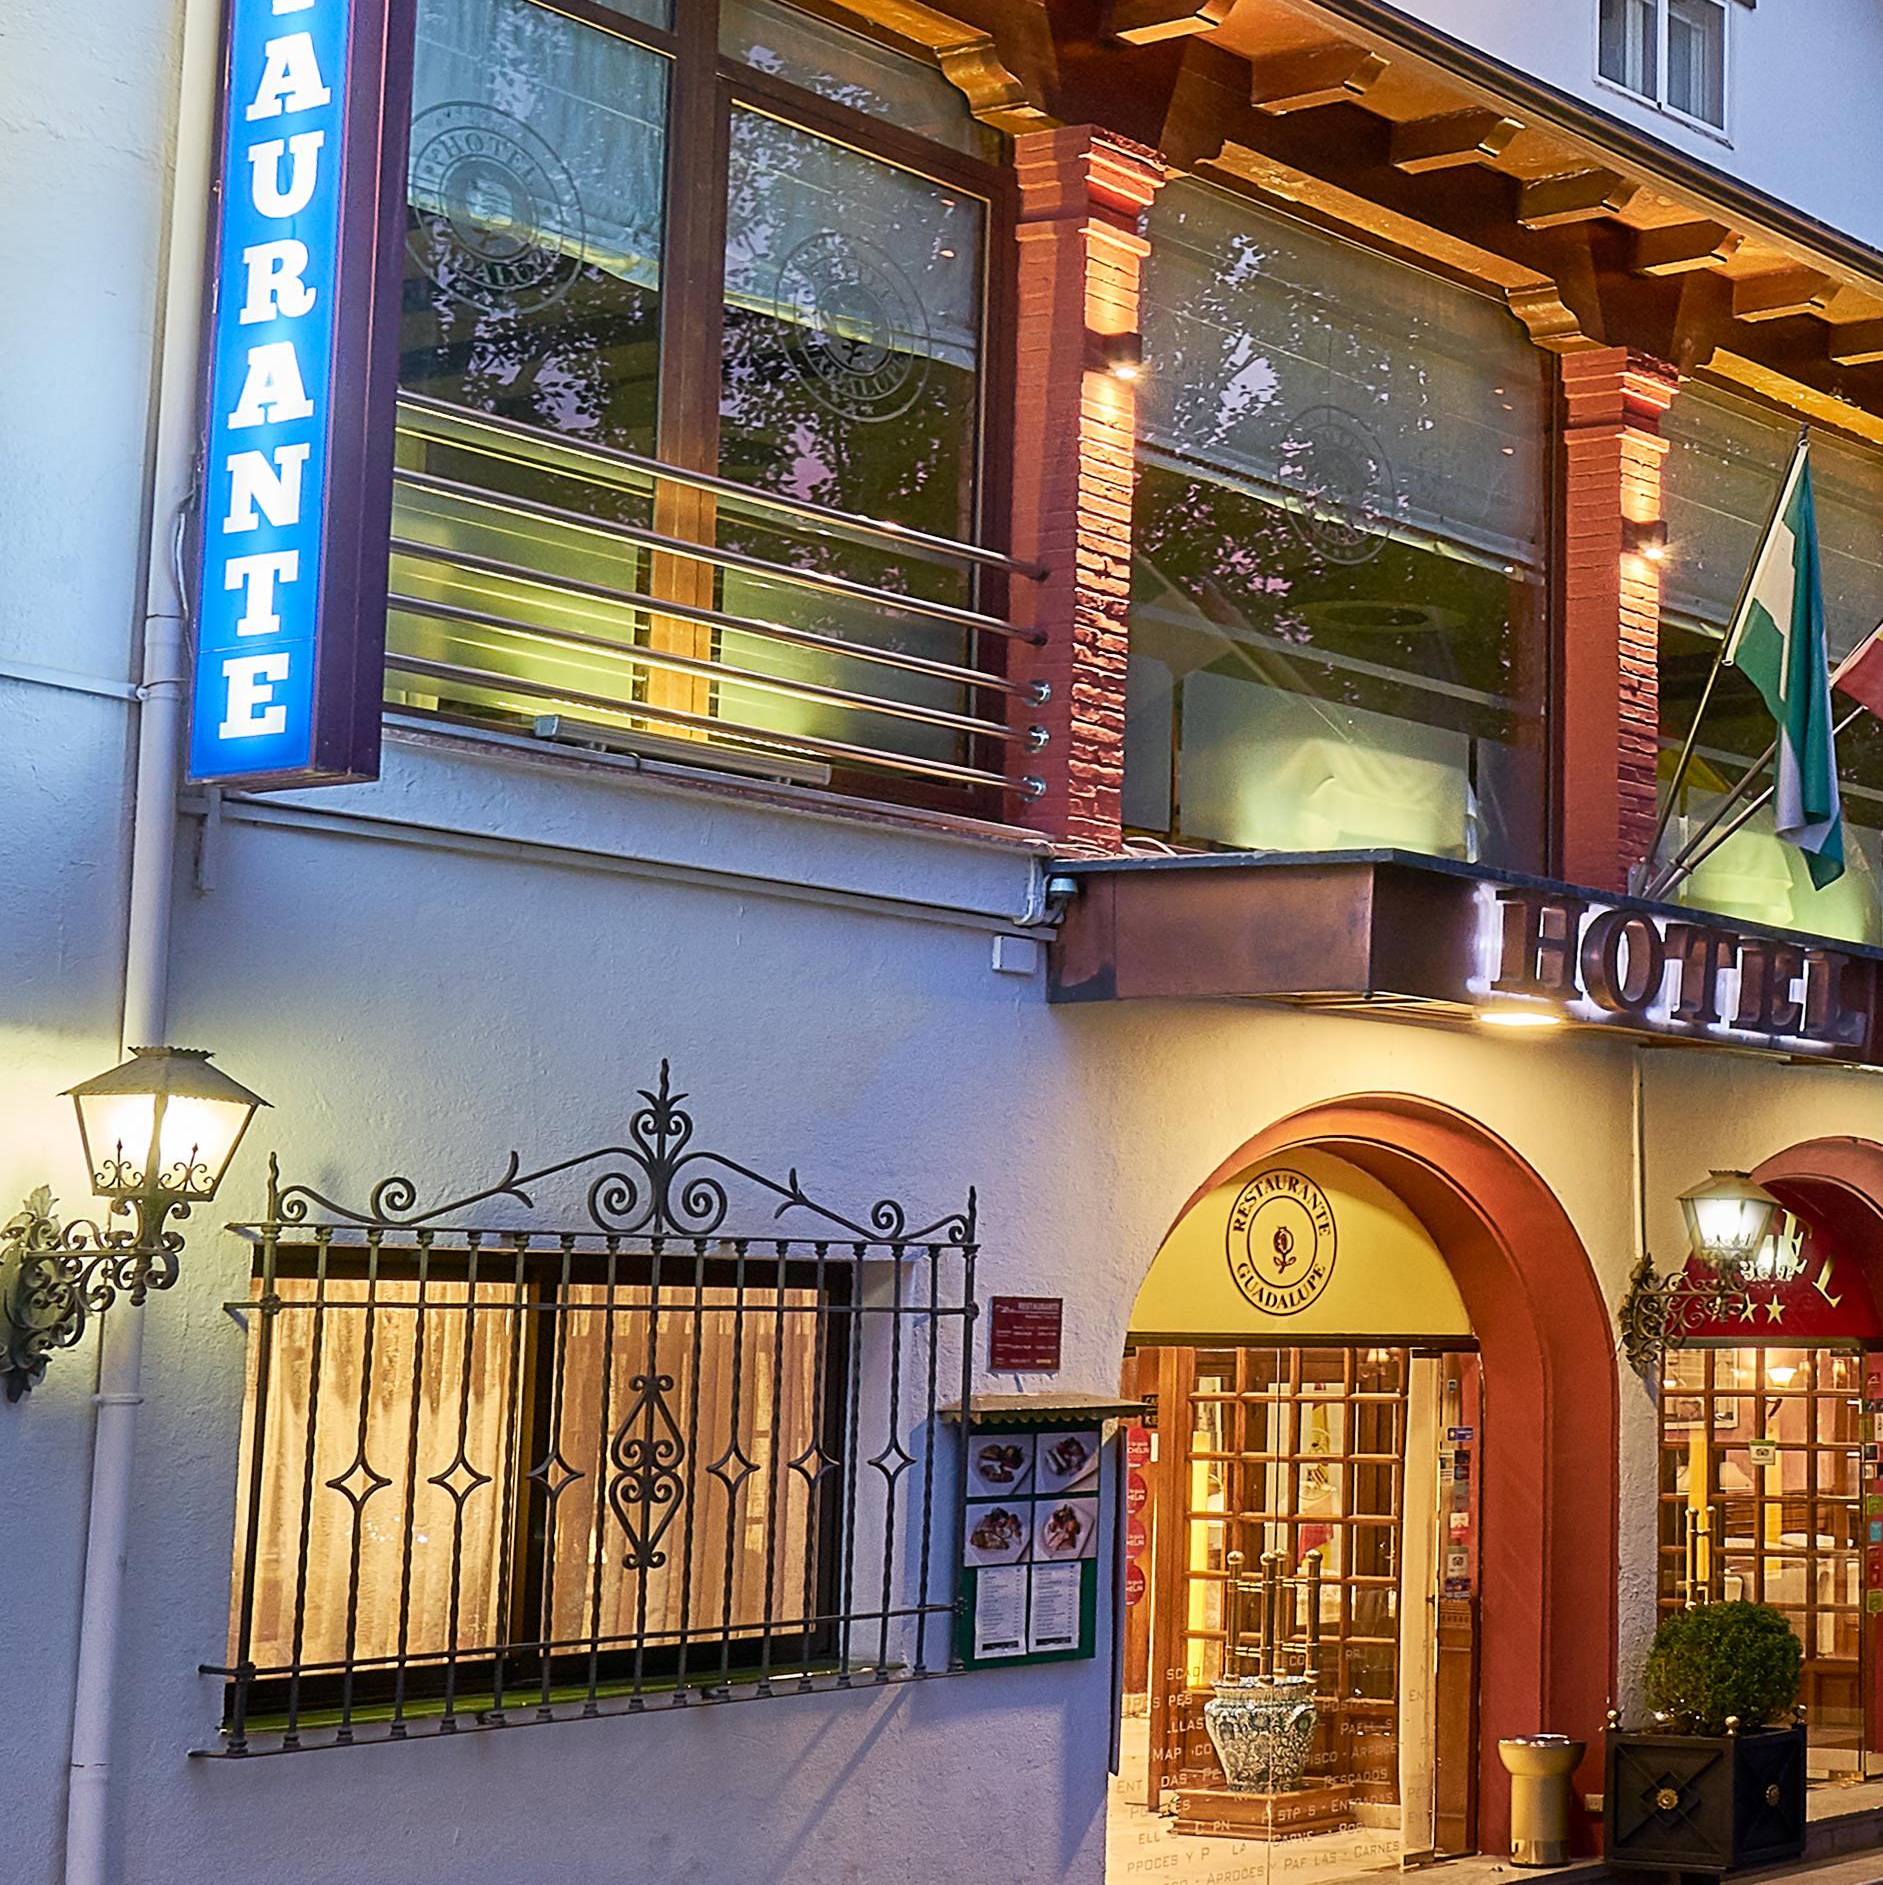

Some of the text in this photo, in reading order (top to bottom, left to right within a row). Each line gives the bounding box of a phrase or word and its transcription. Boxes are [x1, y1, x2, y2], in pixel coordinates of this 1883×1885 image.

[436, 131, 539, 187] HOTEL
[1490, 888, 1866, 1046] HOTEL
[1232, 1173, 1332, 1237] RESTAURANTE
[1235, 1262, 1327, 1310] GUADALUPE
[1353, 1841, 1400, 1859] CARNES
